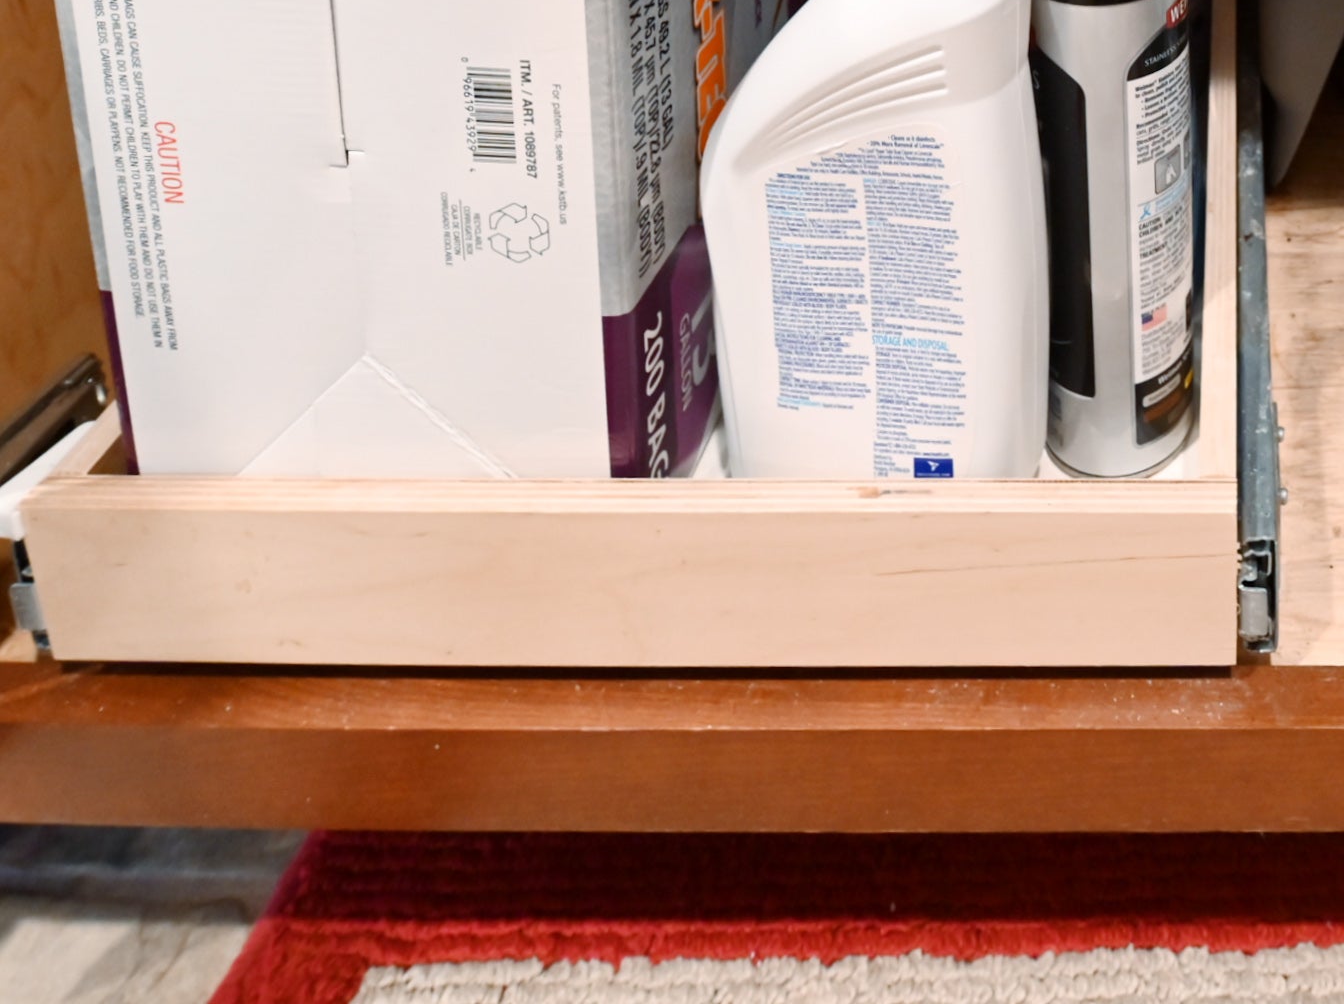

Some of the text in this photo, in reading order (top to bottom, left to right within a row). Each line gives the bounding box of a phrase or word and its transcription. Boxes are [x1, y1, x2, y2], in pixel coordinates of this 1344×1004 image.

[644, 15, 656, 52] 45.7
[659, 19, 672, 59] 49.2
[520, 60, 532, 86] ITM.
[522, 99, 534, 126] ART.
[153, 120, 185, 205] CAUTION
[524, 132, 537, 178] 1089787
[872, 336, 948, 350] STORAGE AND DISPOSAL
[643, 311, 669, 477] 200 BAG
